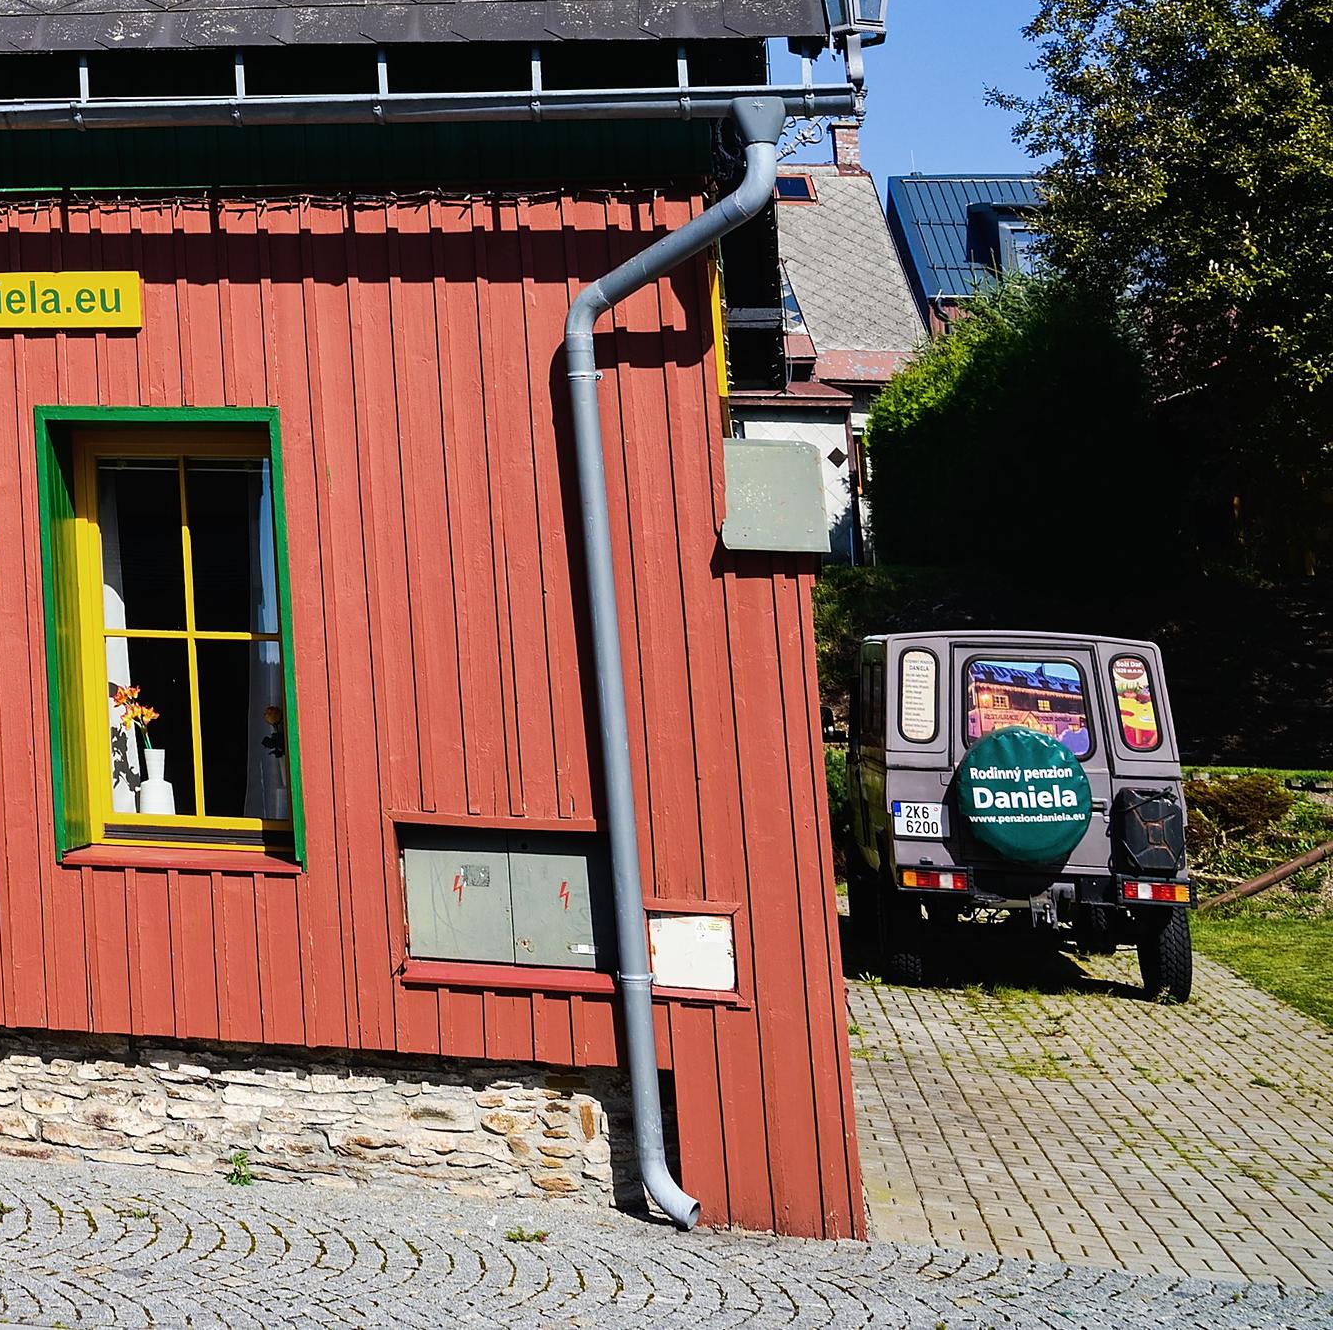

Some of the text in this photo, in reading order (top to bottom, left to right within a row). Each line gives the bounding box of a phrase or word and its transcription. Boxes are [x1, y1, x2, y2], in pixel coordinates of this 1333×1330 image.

[969, 766, 1073, 782] Rodinný penzion
[972, 785, 1078, 809] Daniela
[905, 805, 930, 819] 2K6
[969, 813, 1085, 825] www.penziondaniela.eu
[906, 820, 939, 835] 6200
